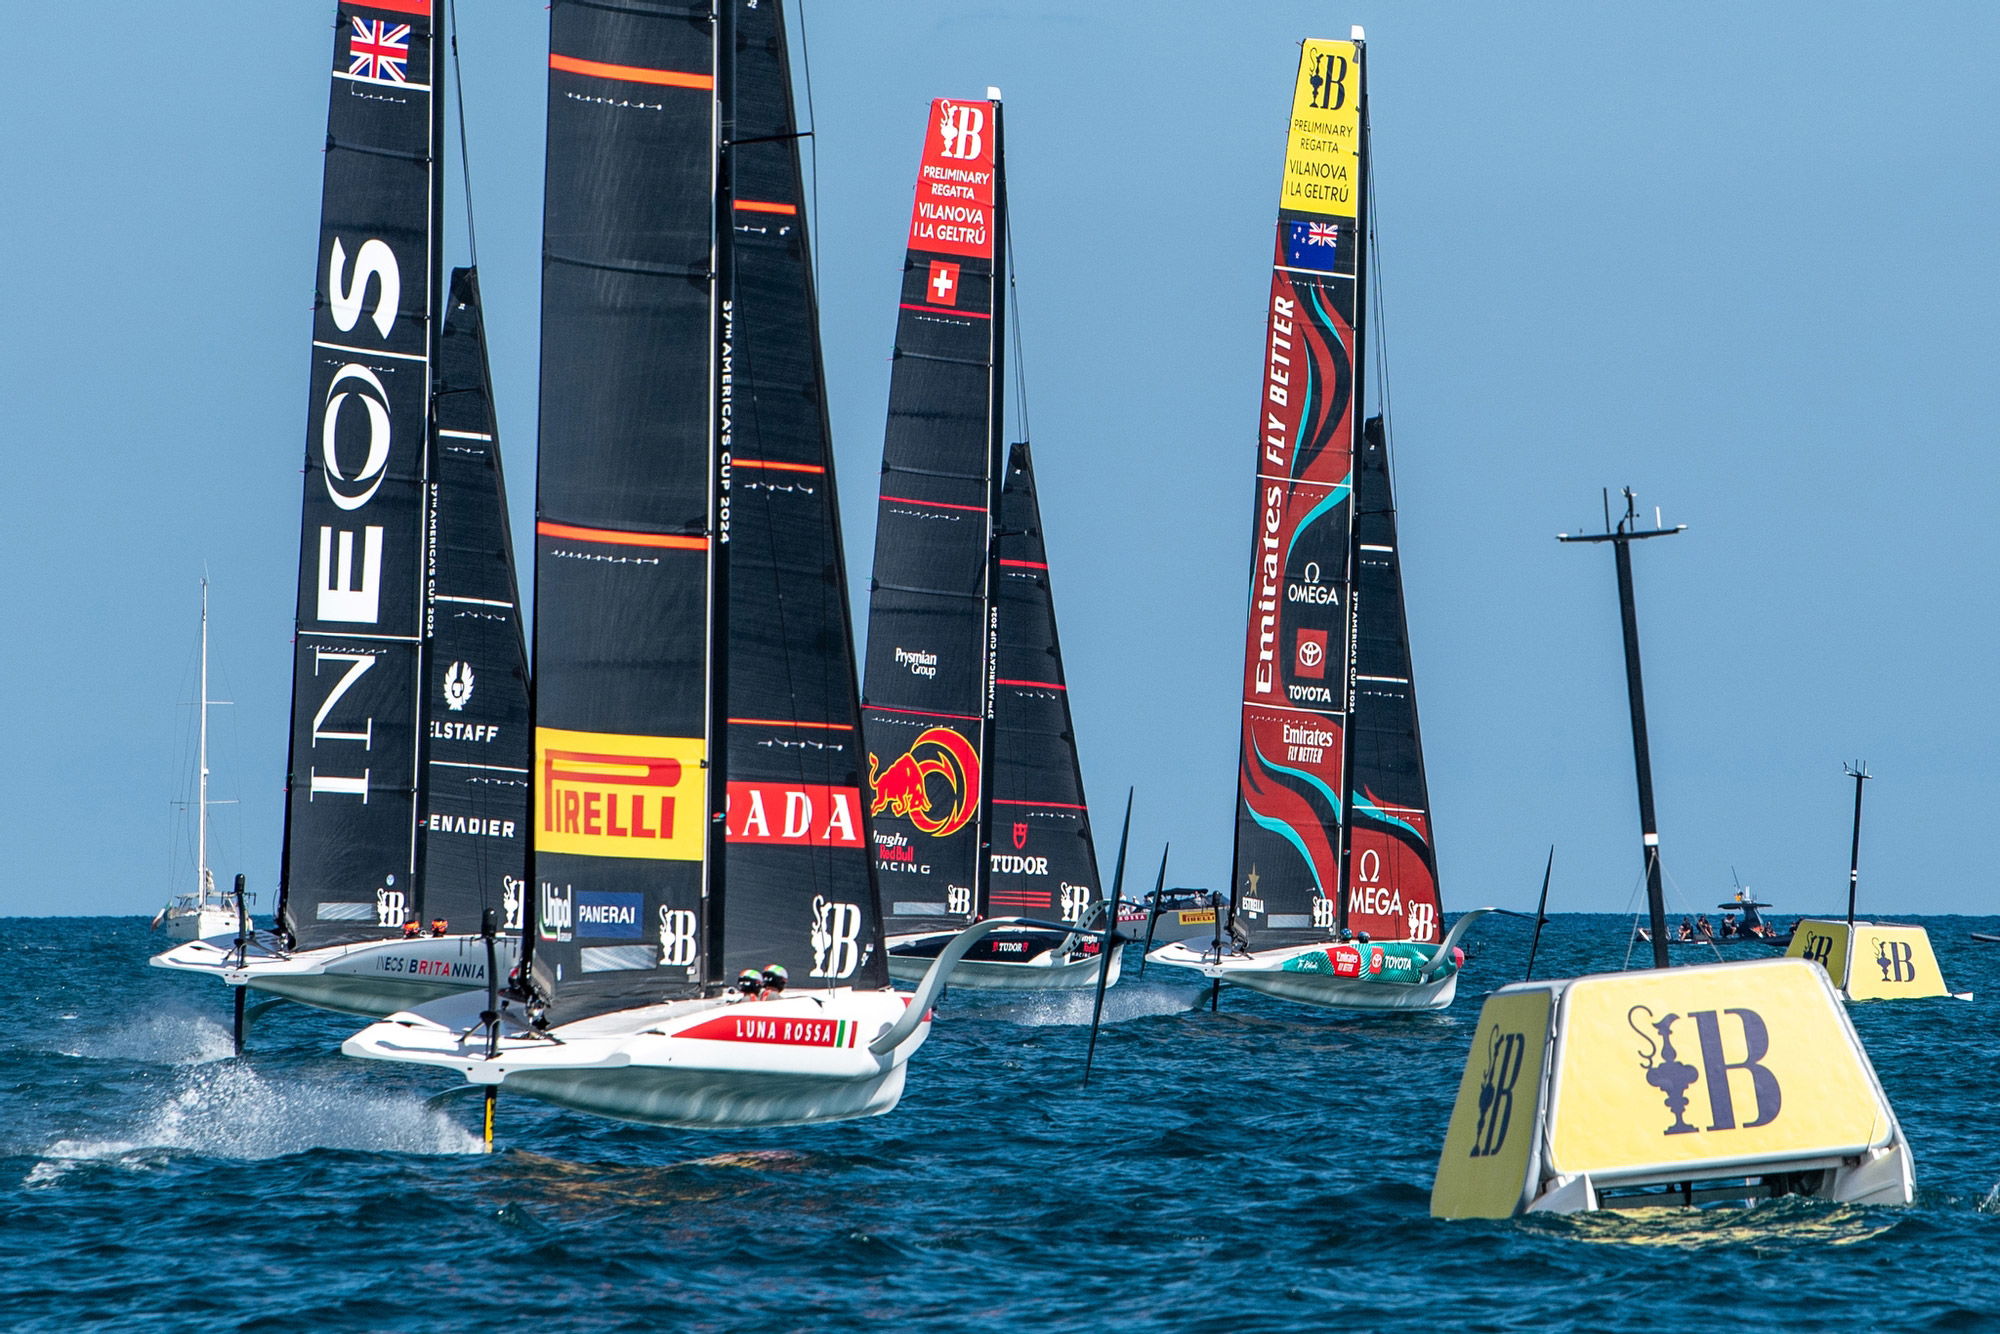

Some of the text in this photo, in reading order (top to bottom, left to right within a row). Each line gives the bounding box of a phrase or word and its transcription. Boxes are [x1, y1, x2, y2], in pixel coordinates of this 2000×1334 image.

[1294, 118, 1354, 138] PRELIMINARY
[1300, 138, 1339, 155] REGATTA
[923, 165, 990, 185] PRELIMINARY
[1289, 158, 1347, 182] VILANOVA
[931, 183, 975, 200] REGATTA
[1290, 182, 1302, 198] LA
[1304, 183, 1350, 203] GELTRÚ
[919, 202, 984, 225] VILANOVA
[920, 222, 934, 239] LA
[936, 224, 987, 245] GELTRÚ
[720, 342, 733, 447] AMERICA'S
[720, 452, 732, 491] CUP
[1255, 295, 1295, 695] Emirates FLY BETTER
[310, 236, 402, 804] INEOS
[719, 496, 731, 545] 2024
[428, 510, 437, 576] AMERICA'S
[427, 579, 436, 605] CUP
[1288, 583, 1339, 606] OMEGA
[426, 608, 435, 639] 2024
[895, 647, 938, 667] Prysmian
[911, 663, 936, 680] Group
[1289, 684, 1332, 703] TOYOTA
[1283, 723, 1333, 748] Emirates
[1298, 748, 1323, 763] BETTER
[544, 748, 682, 840] PIRELLI
[429, 813, 516, 839] ENADIER
[990, 855, 1048, 876] TUDOR
[541, 881, 572, 942] Unipol
[578, 904, 636, 925] PANERAI
[998, 942, 1023, 952] TUDOR
[376, 955, 485, 980] INEOS BRITANNIA
[1384, 955, 1412, 970] TOYOTA
[735, 1018, 832, 1043] LUNA ROSSA
[1688, 1007, 1782, 1132] B
